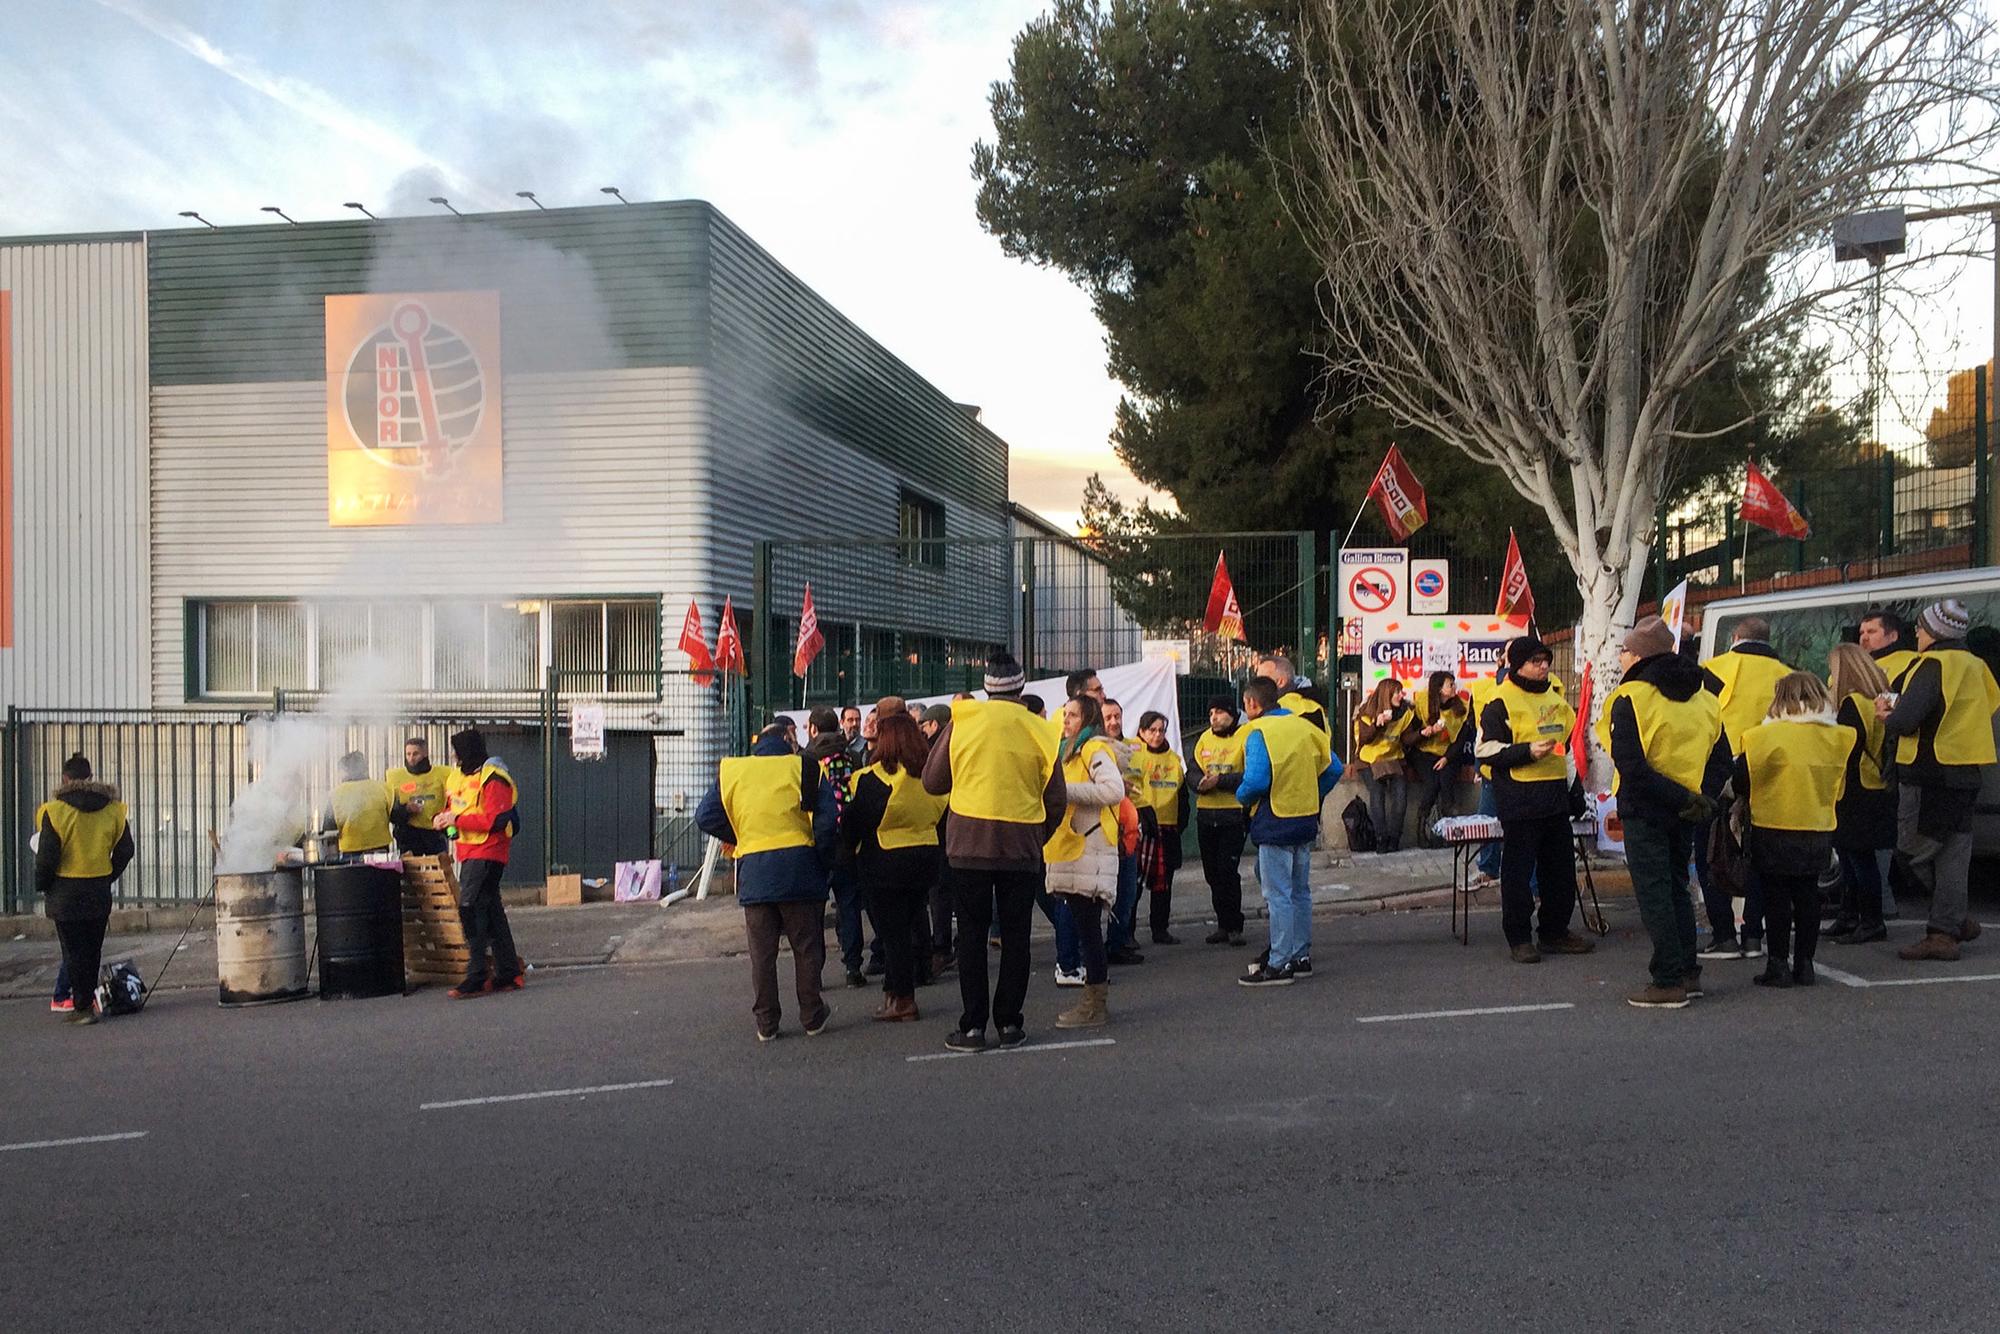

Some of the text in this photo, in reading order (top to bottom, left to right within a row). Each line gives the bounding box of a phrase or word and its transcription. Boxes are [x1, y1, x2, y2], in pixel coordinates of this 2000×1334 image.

[378, 347, 399, 442] NUOR
[1344, 552, 1401, 563] Gallina Blanca
[1377, 643, 1422, 662] Galli
